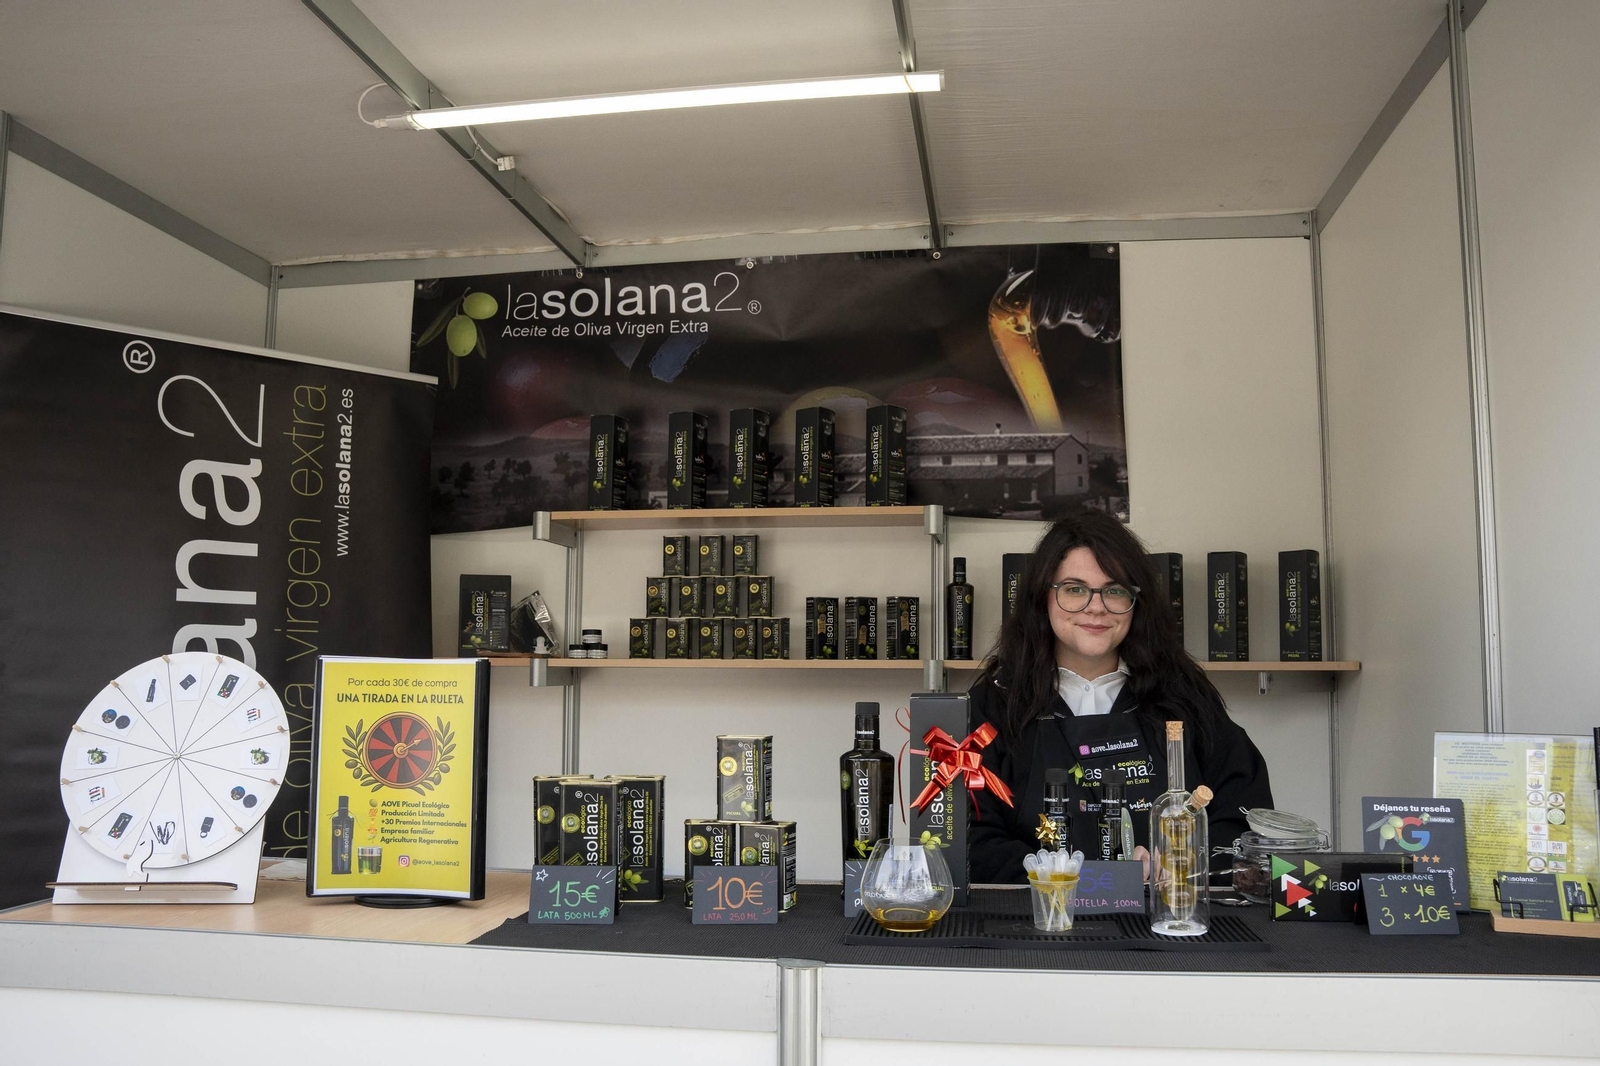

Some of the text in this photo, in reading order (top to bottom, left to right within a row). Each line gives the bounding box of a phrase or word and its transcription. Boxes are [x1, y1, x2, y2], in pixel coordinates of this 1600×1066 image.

[505, 271, 742, 320] lasolana2
[501, 319, 709, 338] Aceite de Oliva Virgen Extra
[282, 384, 327, 497] extra
[334, 388, 354, 557] www.lasolana2.es
[274, 517, 331, 662] virgen
[1216, 572, 1225, 622] lasolana2
[1287, 572, 1296, 622] lasolana2
[474, 590, 484, 635] lasolana2
[825, 600, 834, 645] lasolana2
[868, 600, 876, 645] lasolana2
[337, 693, 464, 704] UNA TIRADA EN LA RULETA
[348, 678, 457, 689] Por cada 30€ de compra
[1091, 739, 1138, 754] aove_lasolana2
[743, 743, 753, 800] lasolana2
[856, 769, 870, 836] lasolana2
[945, 804, 953, 814] de
[1374, 804, 1408, 813] Déjanos
[630, 789, 644, 867] lasolana2
[548, 880, 600, 907] 15€
[706, 876, 764, 910] 10€
[1378, 884, 1388, 897] 1
[1413, 883, 1435, 897] 4€
[538, 910, 560, 919] LATA
[1380, 906, 1395, 927] 3
[1414, 904, 1450, 923] 10€
